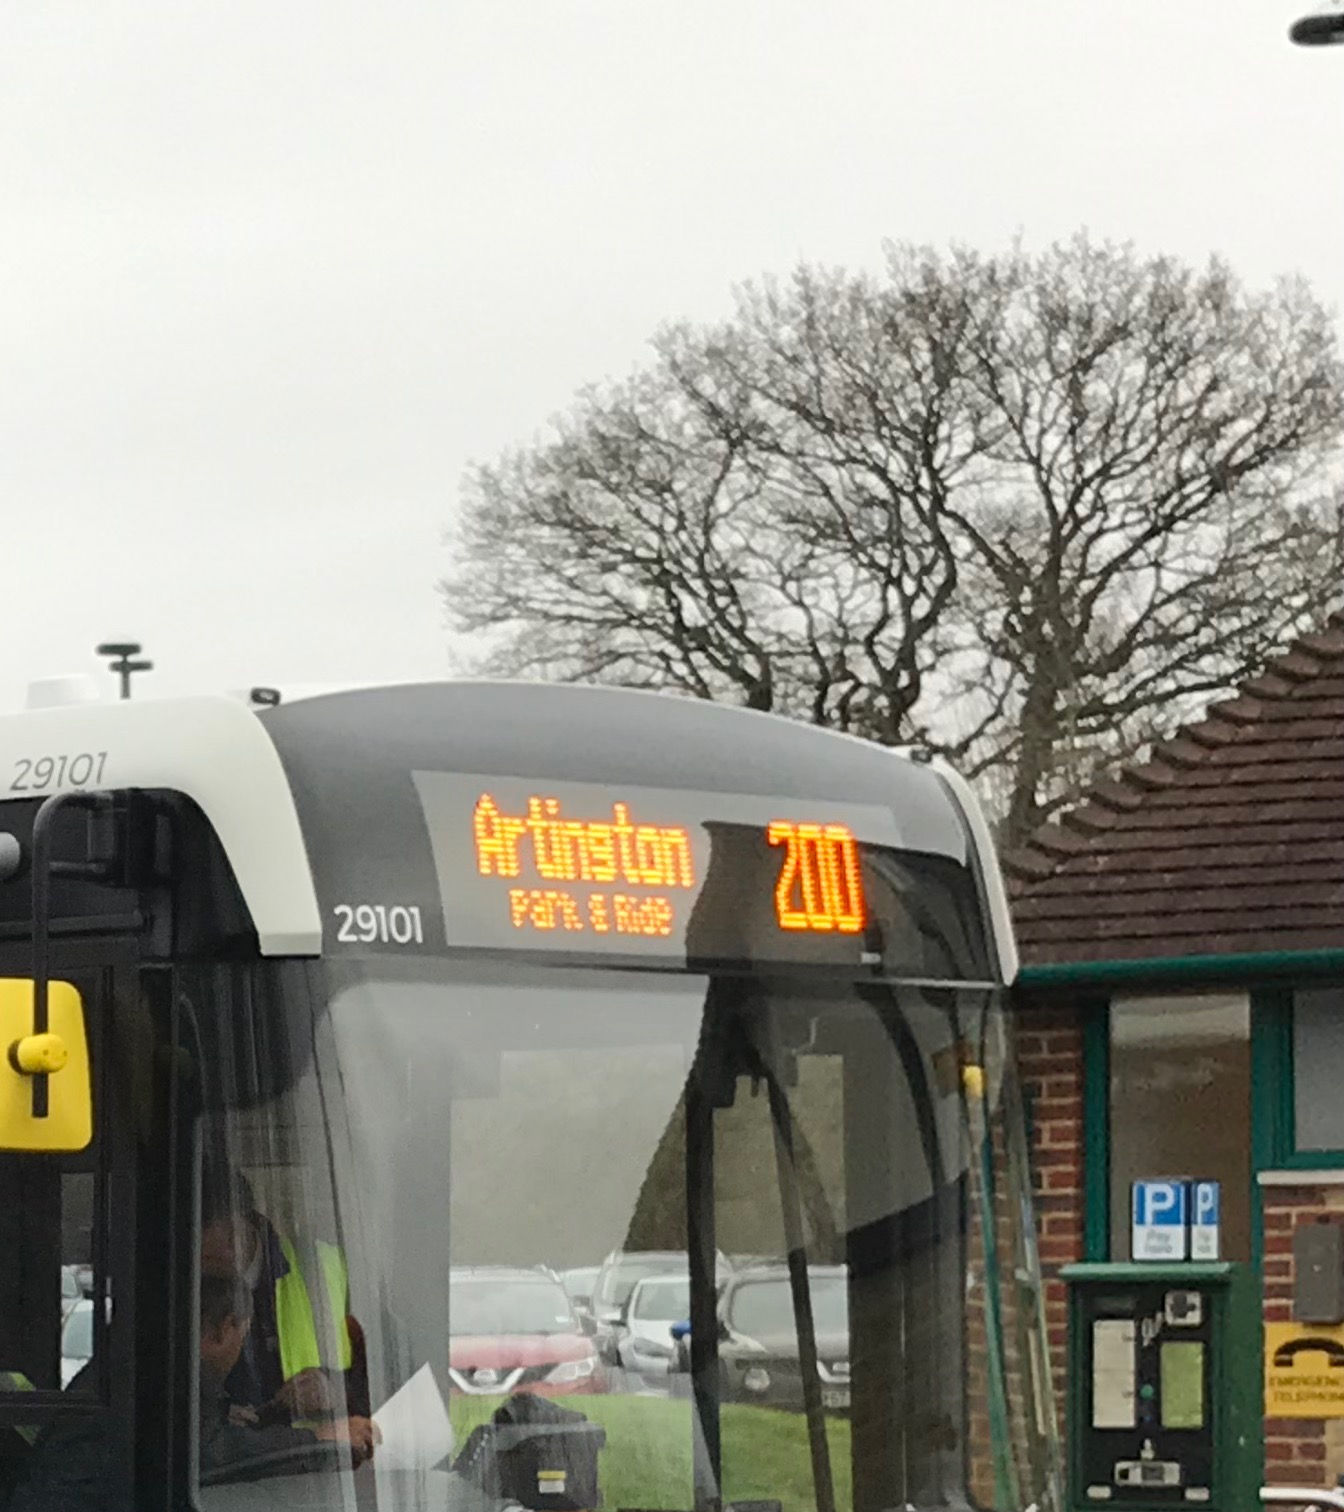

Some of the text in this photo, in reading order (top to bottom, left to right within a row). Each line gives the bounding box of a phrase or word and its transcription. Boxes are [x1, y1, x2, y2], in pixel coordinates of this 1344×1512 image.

[9, 751, 108, 792] 29101
[767, 821, 865, 932] 200
[333, 902, 423, 945] 29101
[1145, 1184, 1174, 1224] P
[1198, 1184, 1213, 1224] P
